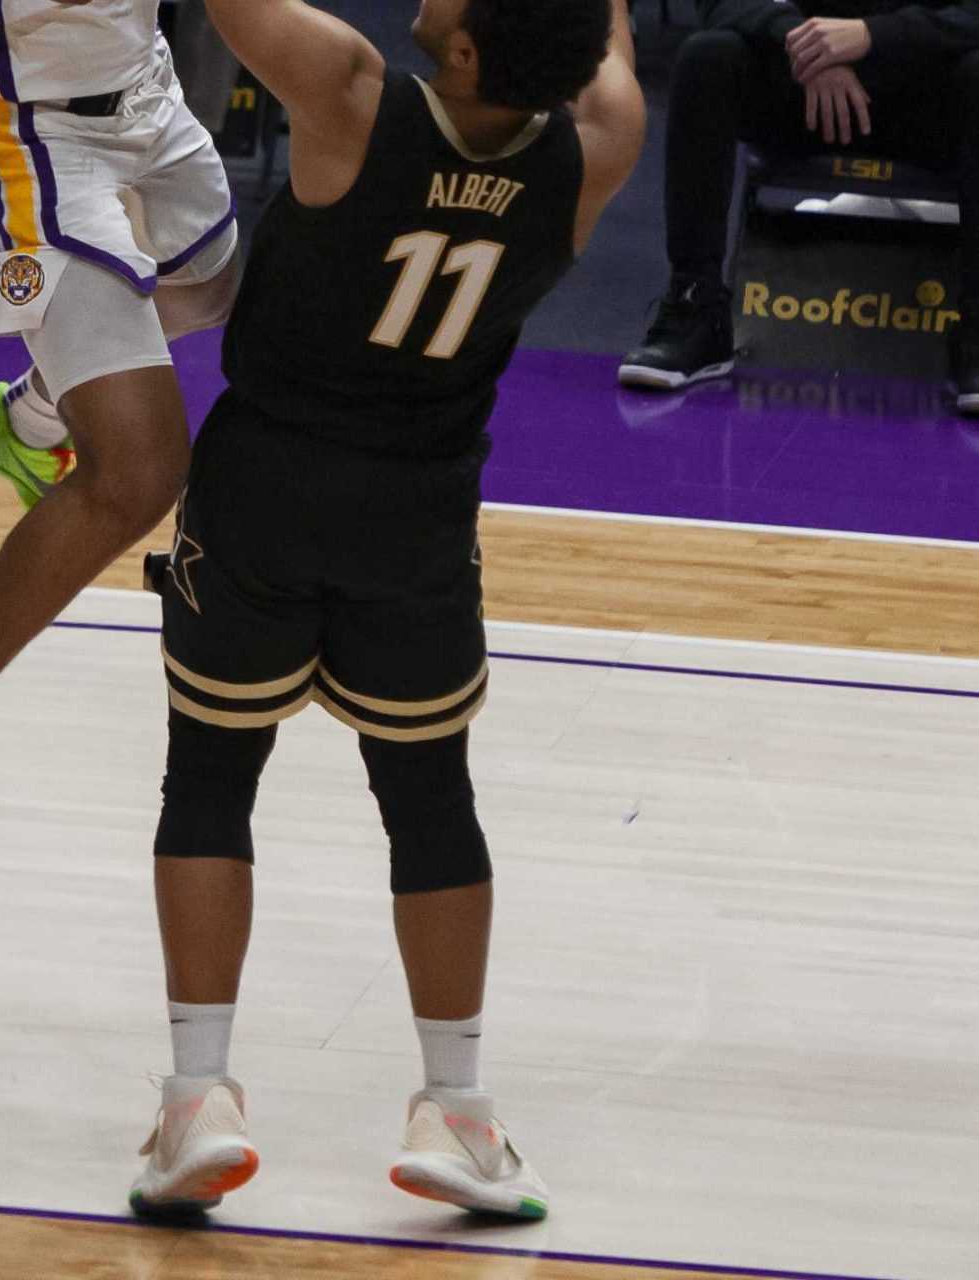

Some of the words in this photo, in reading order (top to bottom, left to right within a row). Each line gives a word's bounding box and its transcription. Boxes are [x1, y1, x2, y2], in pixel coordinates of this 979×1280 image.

[832, 158, 894, 182] LSU
[426, 172, 525, 217] ALBERT
[368, 229, 507, 360] 11
